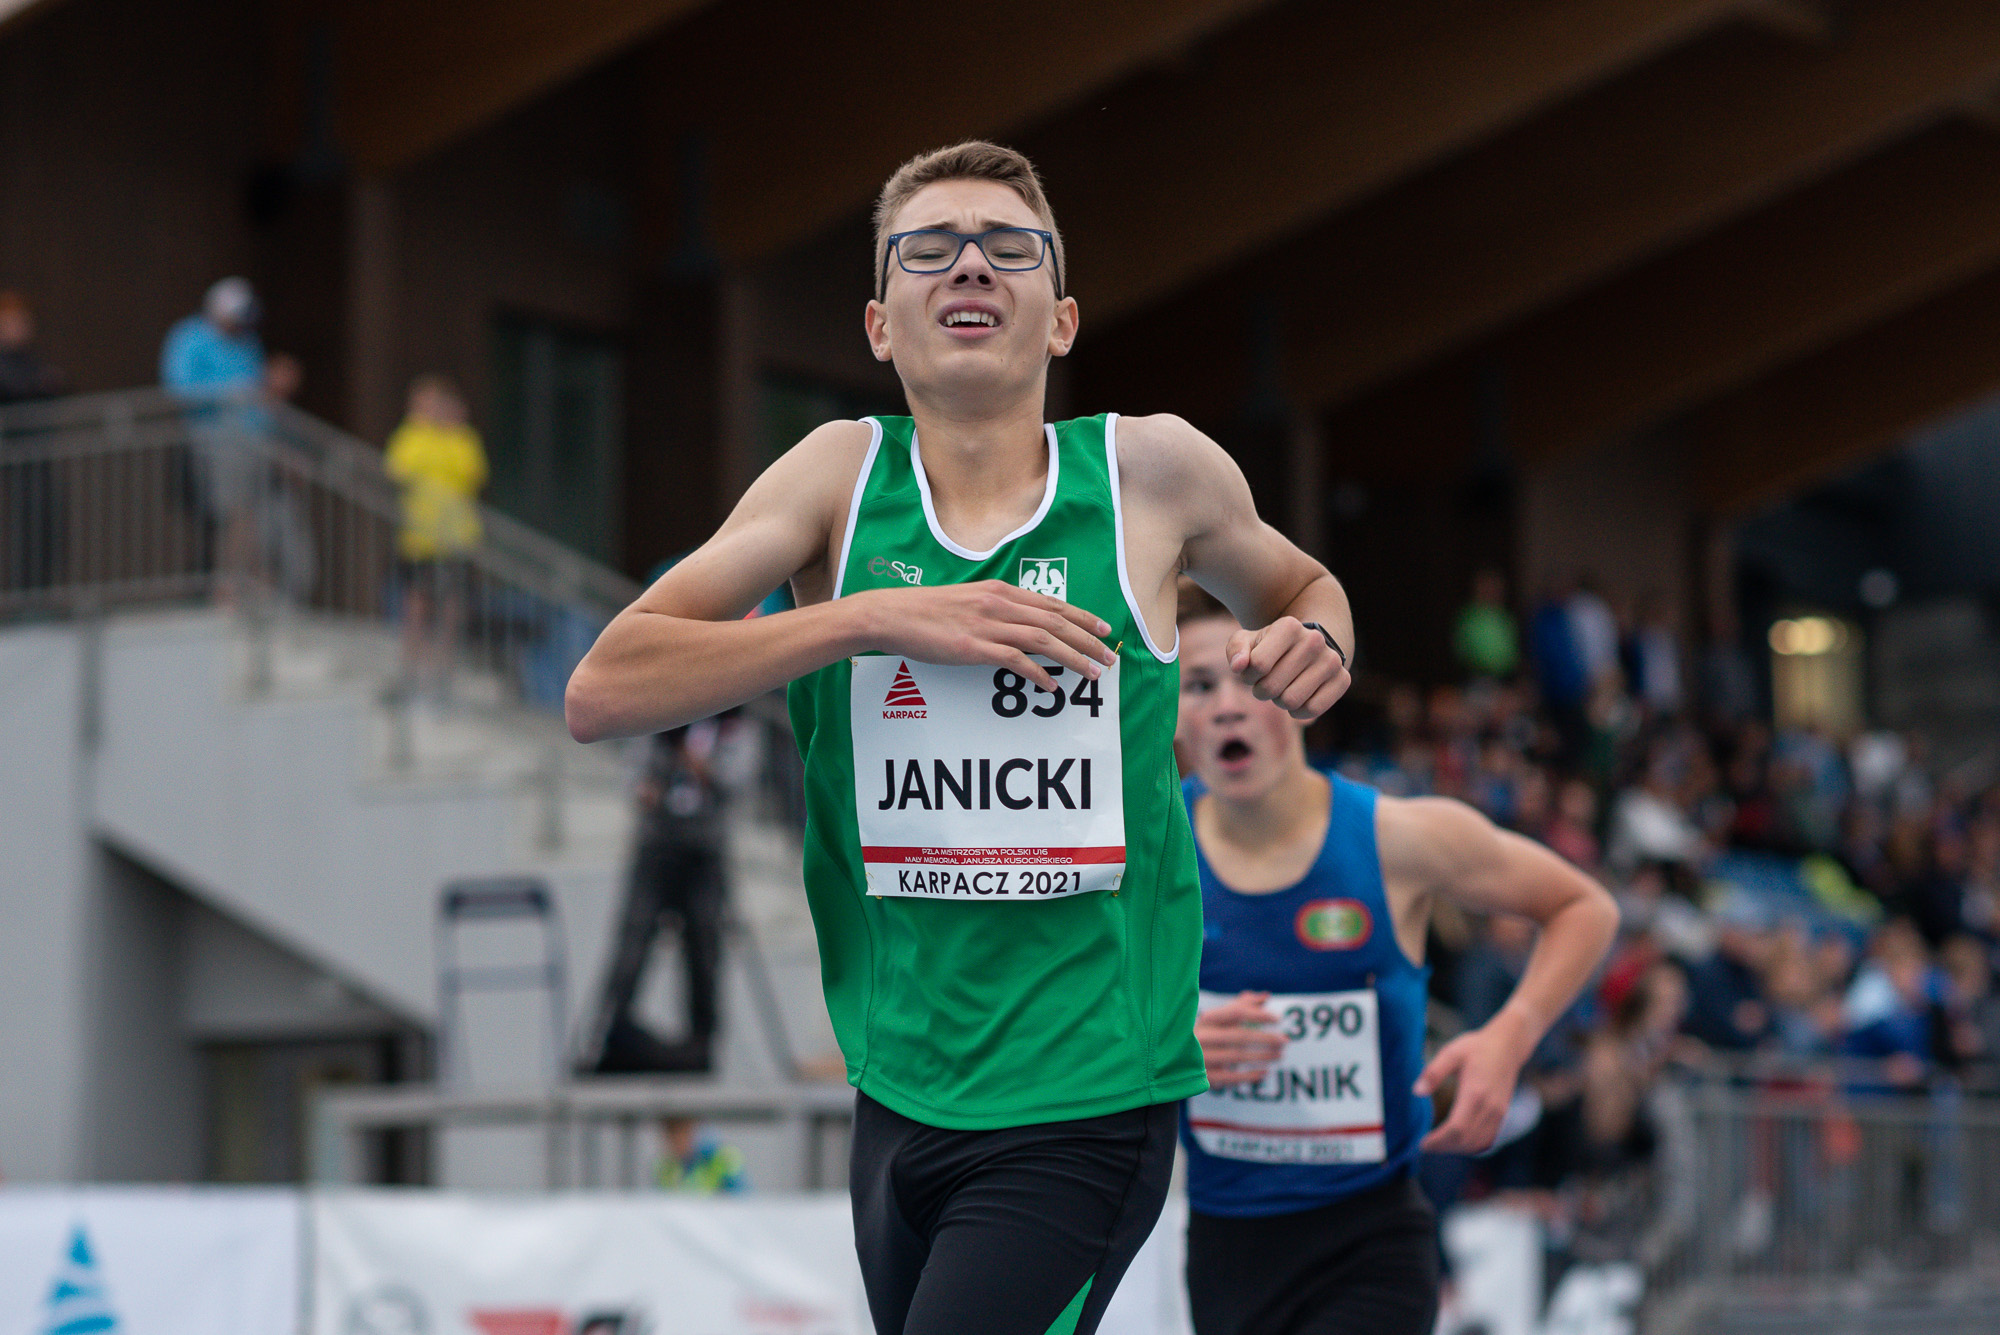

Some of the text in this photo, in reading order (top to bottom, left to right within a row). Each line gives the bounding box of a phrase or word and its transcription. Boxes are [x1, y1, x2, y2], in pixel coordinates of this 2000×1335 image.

[991, 665, 1104, 718] 854
[882, 710, 928, 719] KARPACZ
[878, 758, 1092, 811] JANICKI
[941, 848, 999, 856] MISTRZOSTWA
[1001, 848, 1031, 856] POLSKI
[1033, 848, 1048, 856] U16
[961, 857, 1002, 865] JANUSZA
[1004, 856, 1073, 865] KUSOCIŃSKIEGO
[898, 870, 1081, 895] KARPACZ 2021
